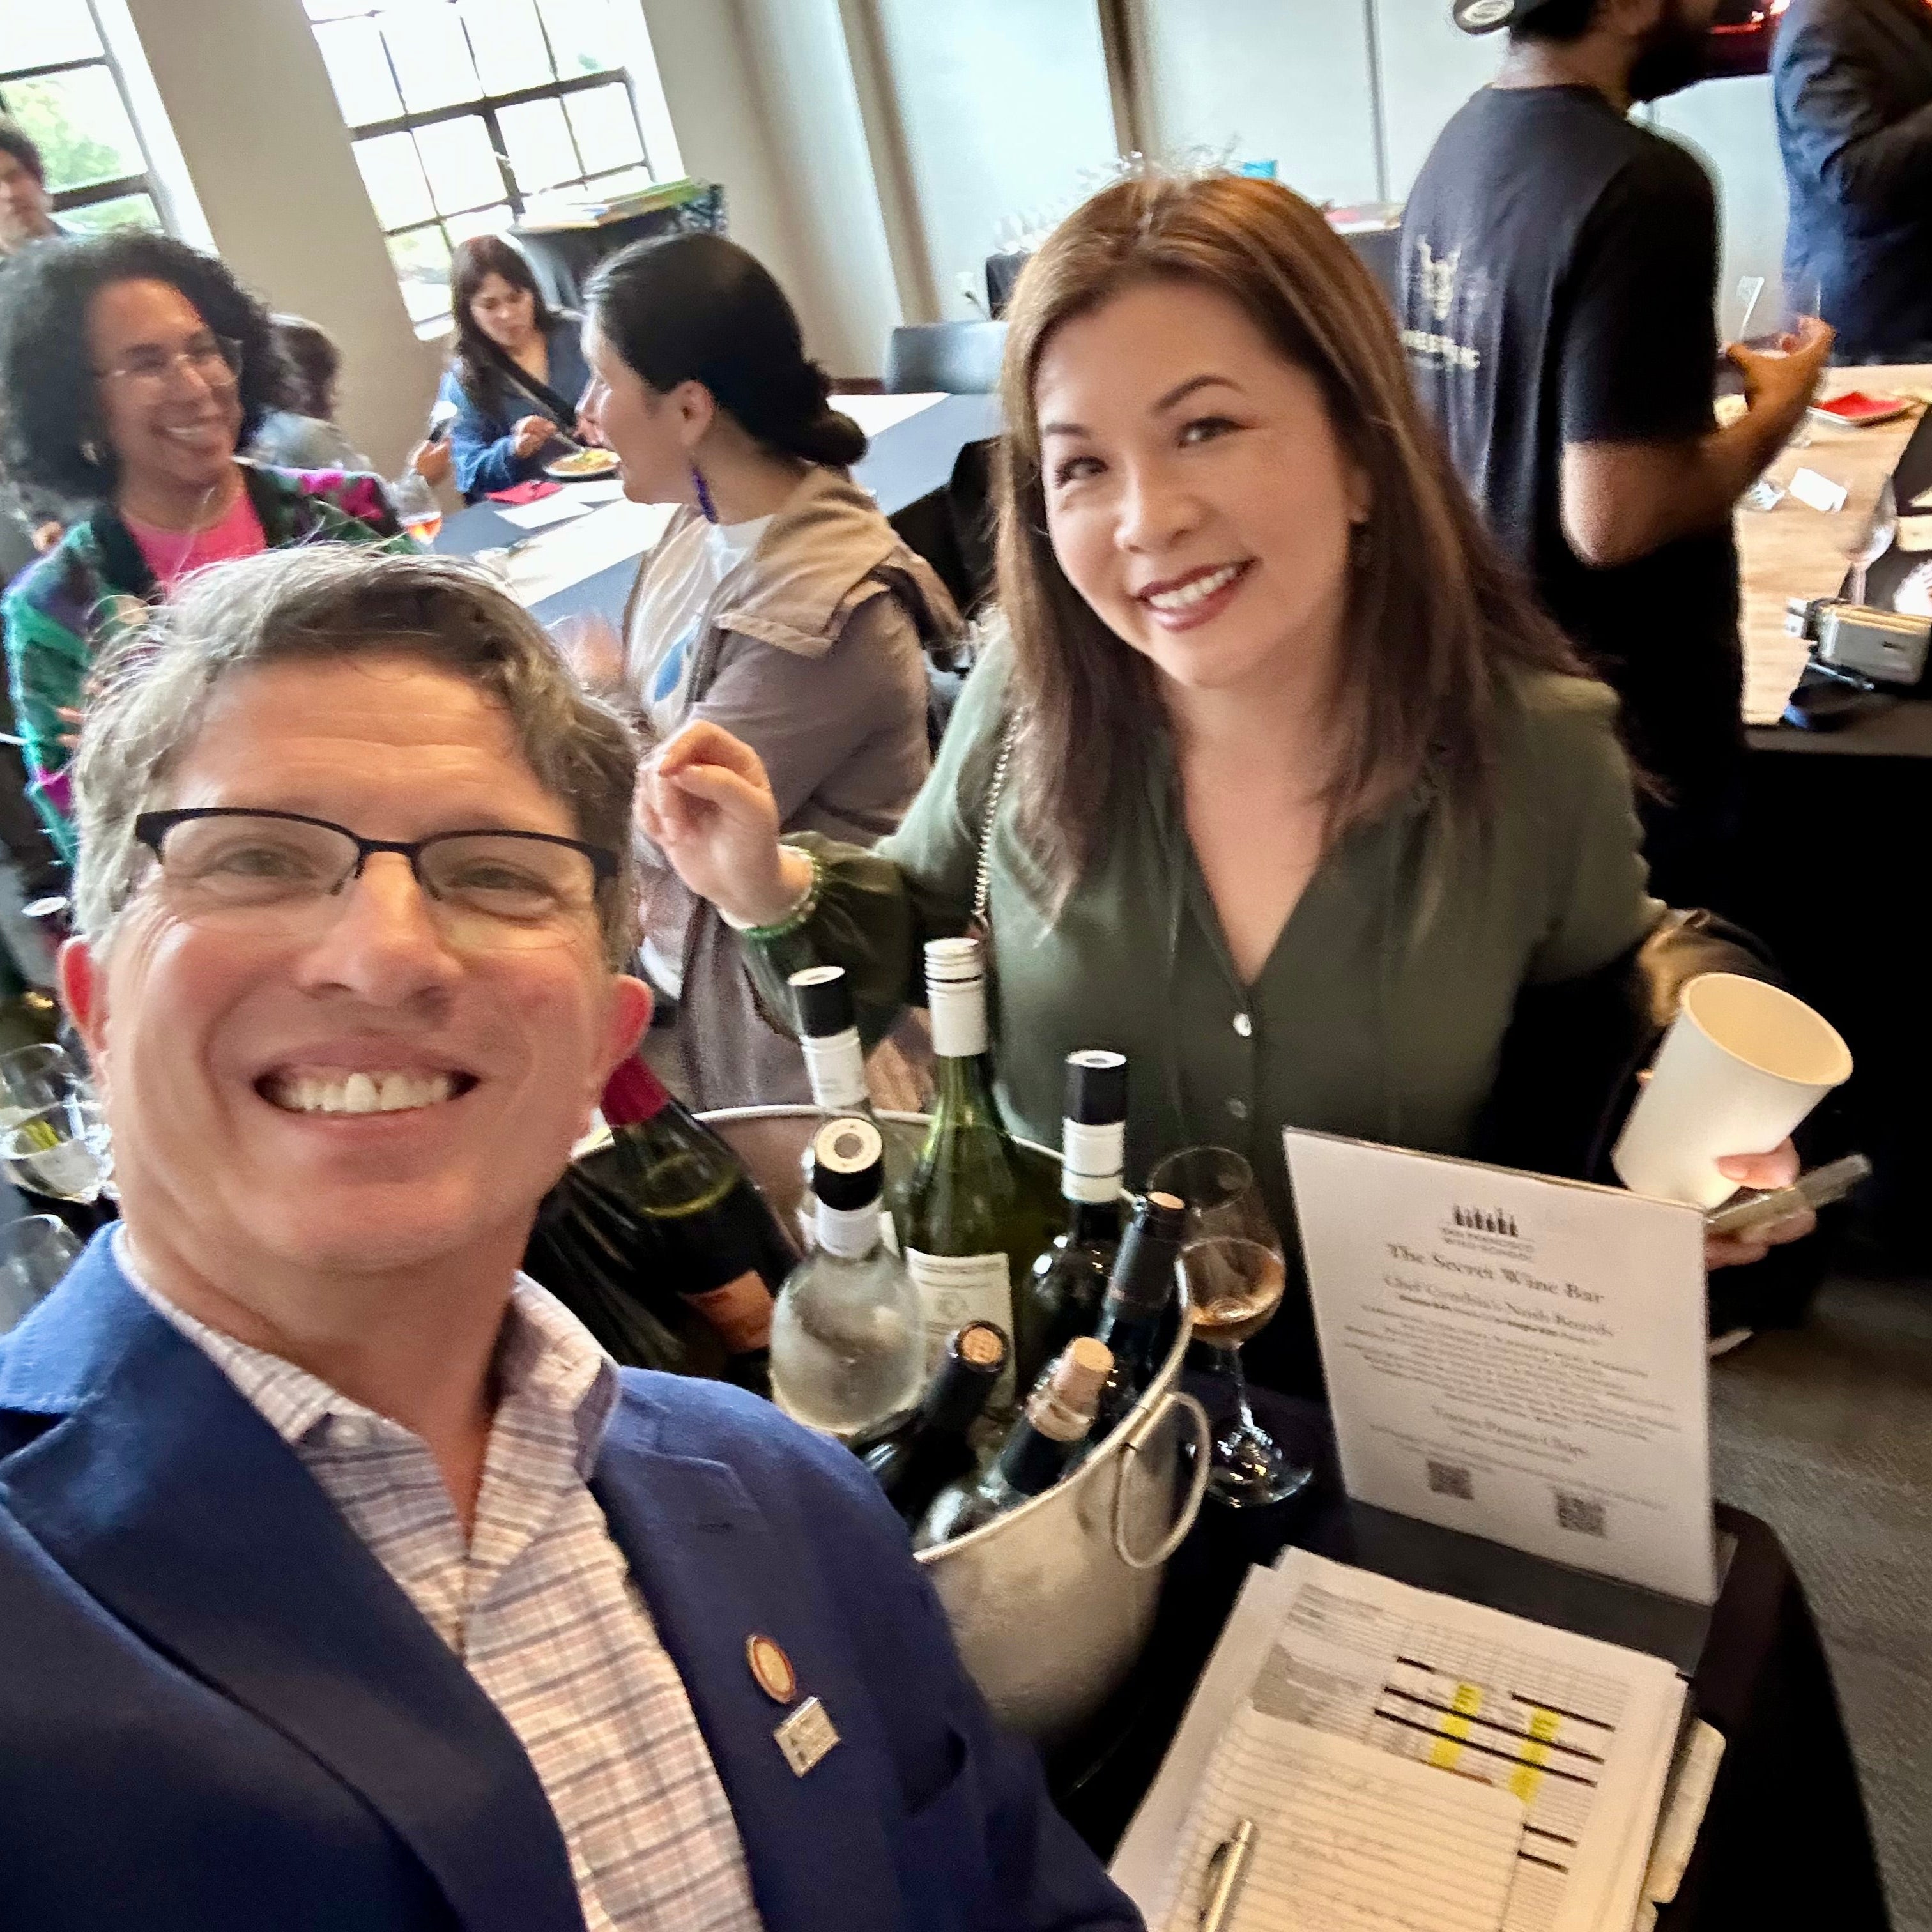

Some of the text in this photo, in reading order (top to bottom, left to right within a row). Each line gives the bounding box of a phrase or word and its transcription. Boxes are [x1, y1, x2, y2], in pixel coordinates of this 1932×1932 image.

[1385, 1243, 1425, 1265] The
[1432, 1252, 1495, 1280] Secret
[1499, 1268, 1558, 1295] Wine
[1565, 1282, 1605, 1304] Bar
